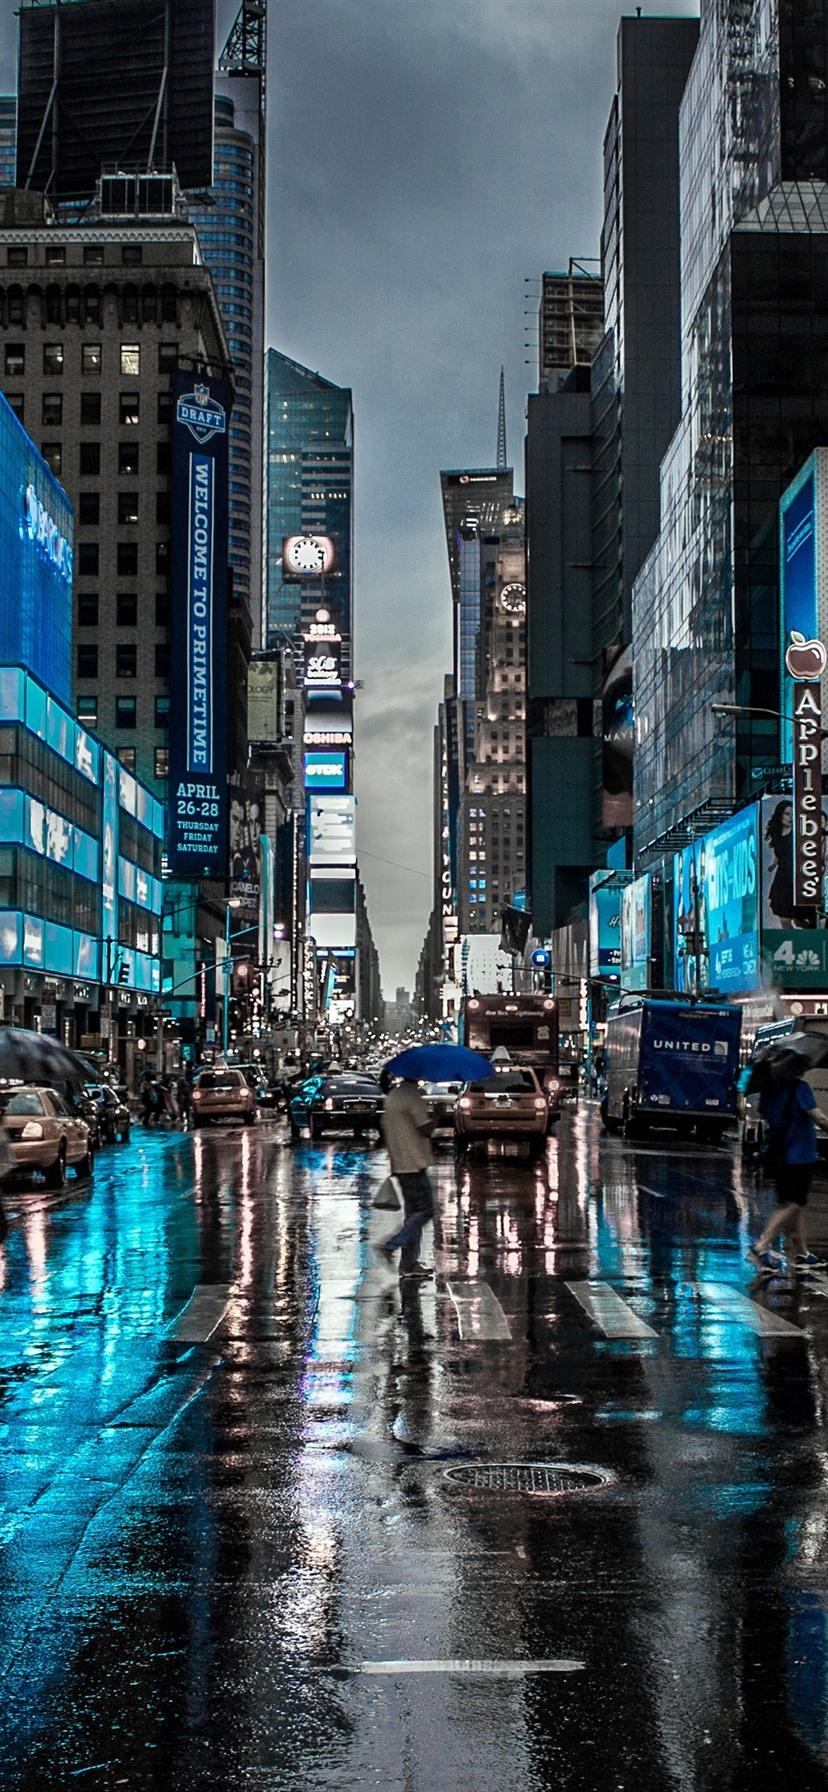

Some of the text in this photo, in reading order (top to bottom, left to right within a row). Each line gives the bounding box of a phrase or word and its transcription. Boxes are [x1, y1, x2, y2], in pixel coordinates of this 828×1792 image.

[181, 406, 222, 426] DRAFT
[193, 463, 209, 764] WELCOME TO PRIMETIME
[176, 782, 220, 800] APRIL
[795, 688, 821, 898] Applebee's
[177, 800, 219, 817] 26-28
[176, 821, 220, 831] THURSDAY
[183, 832, 213, 842] FRIDAY
[176, 843, 220, 854] SATURDAY
[774, 940, 795, 965] 4
[653, 1039, 711, 1052] UNITED
